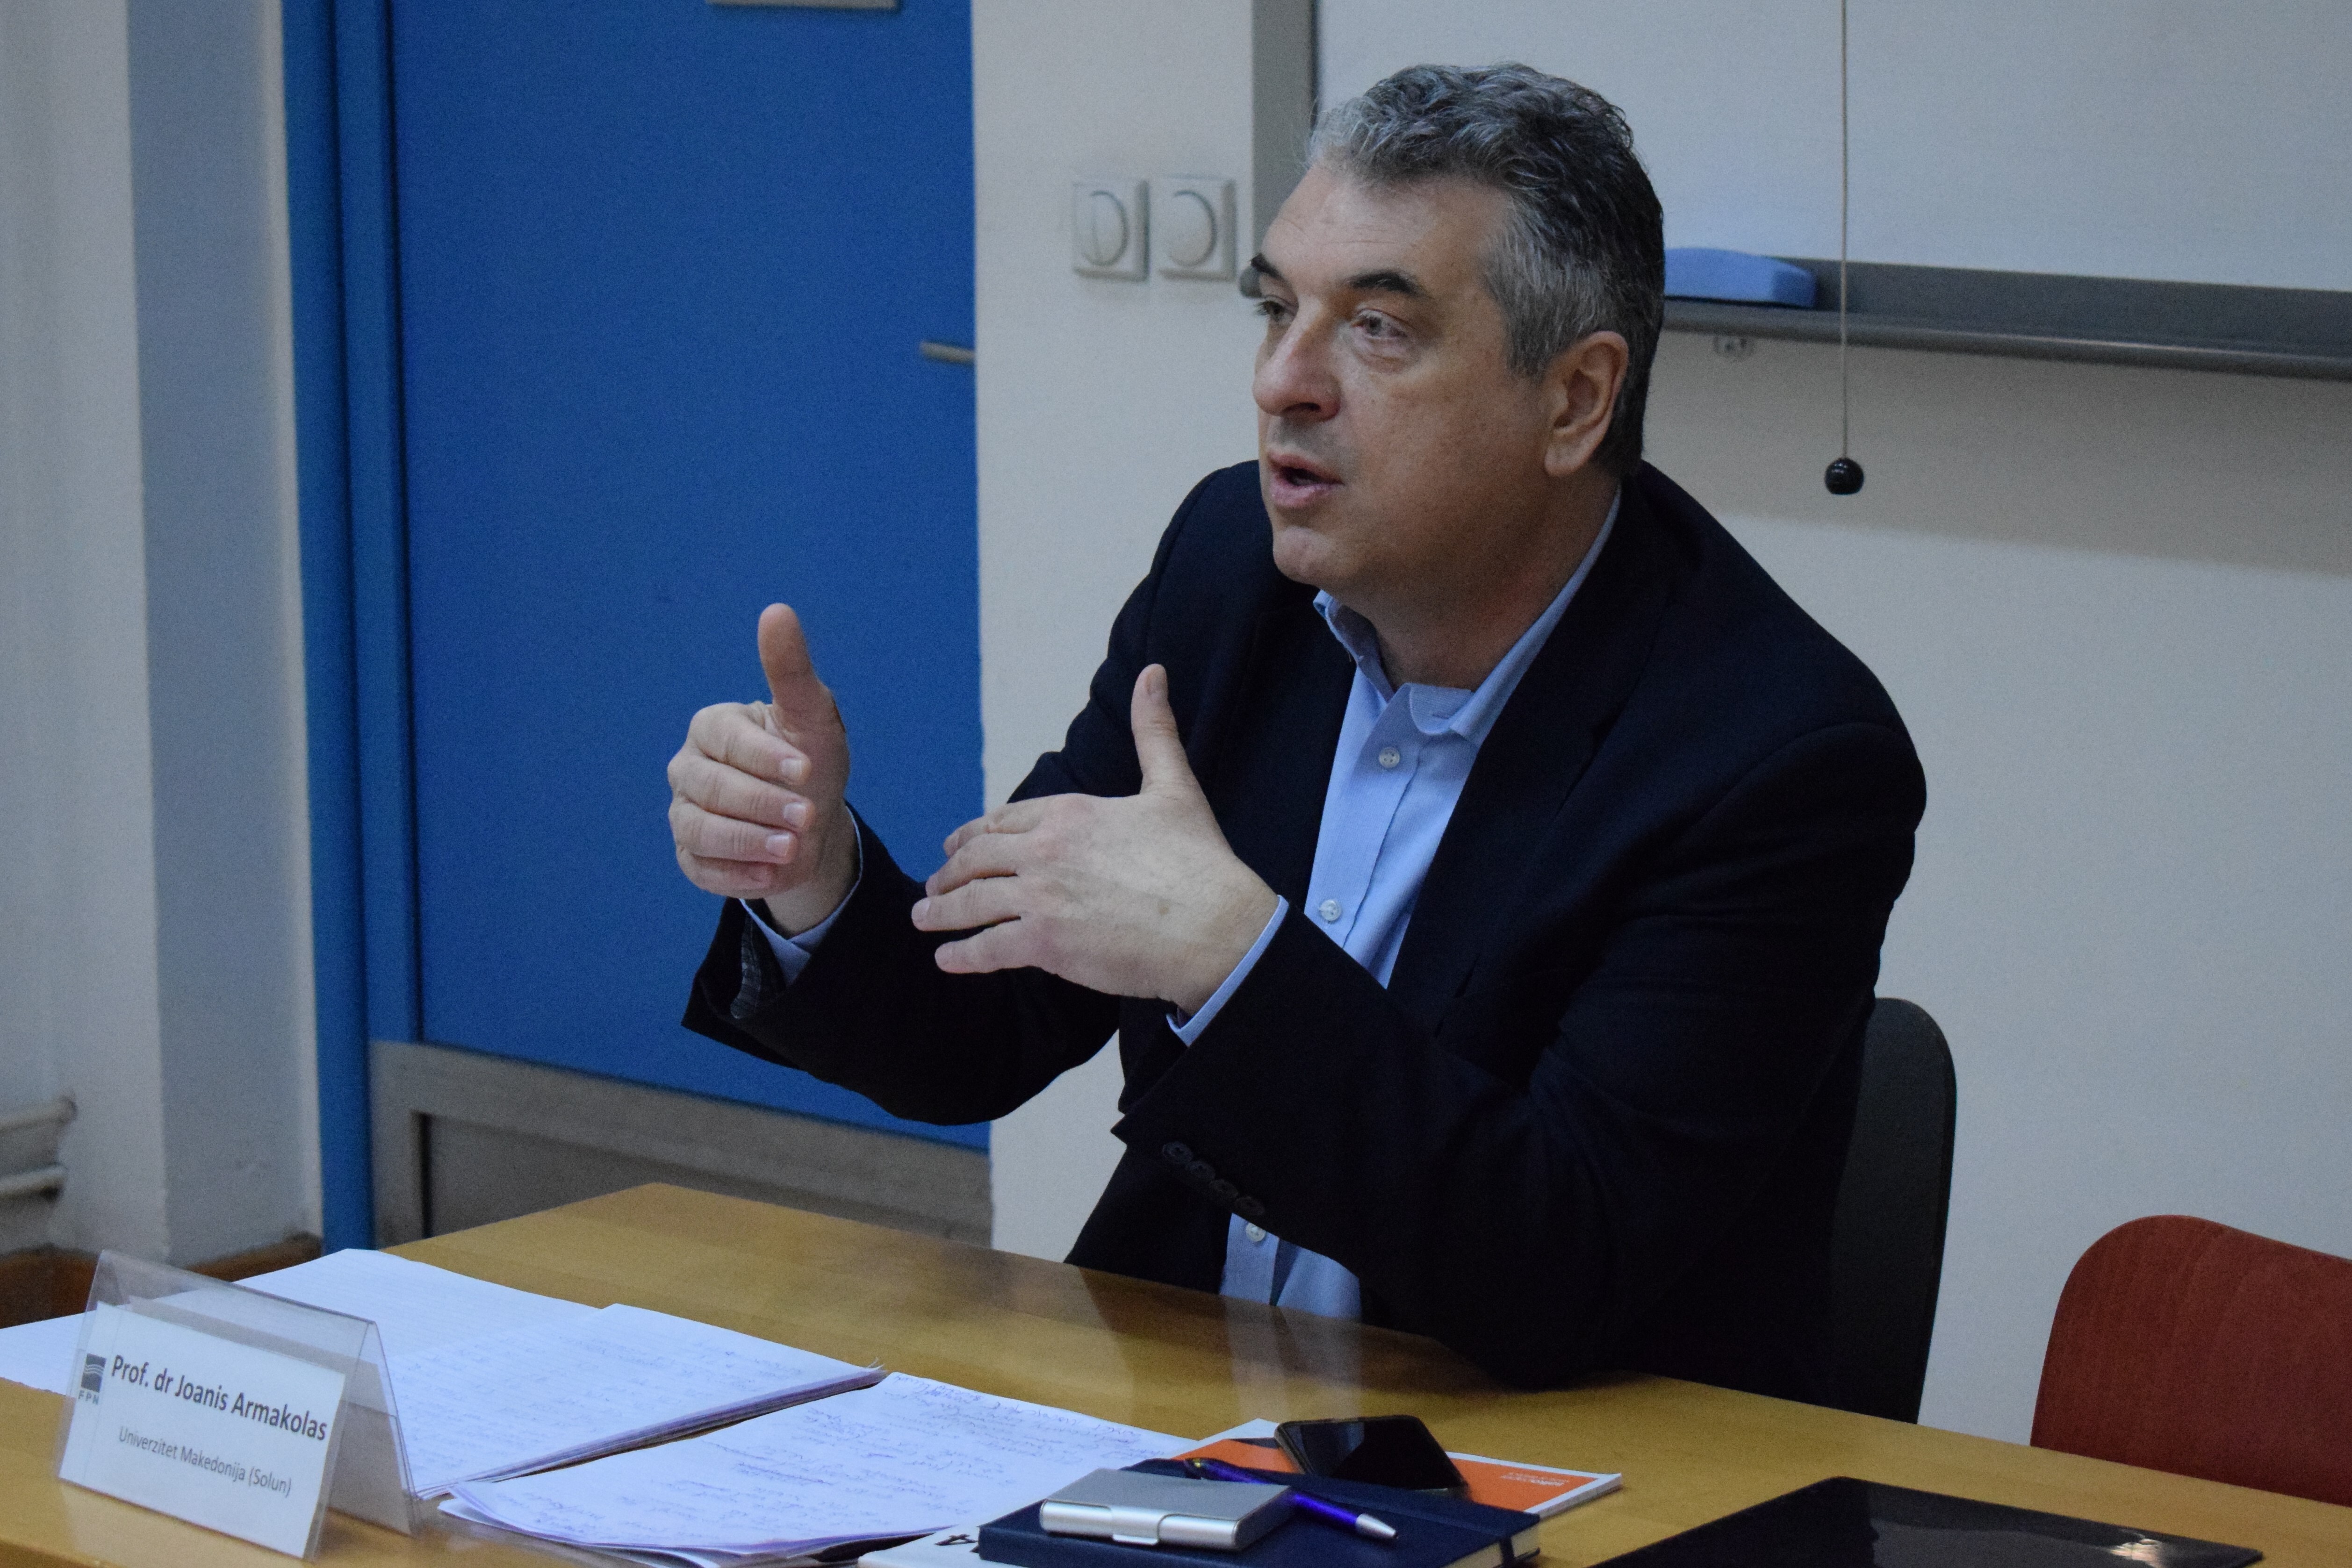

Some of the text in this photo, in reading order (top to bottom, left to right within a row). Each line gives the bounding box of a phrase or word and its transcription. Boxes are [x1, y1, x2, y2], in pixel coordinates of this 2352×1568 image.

[78, 1389, 99, 1405] FPN
[111, 1354, 327, 1441] Prof. dr Joanis Armakolas
[119, 1426, 292, 1498] Univerzitet Makedonija (Solun)
